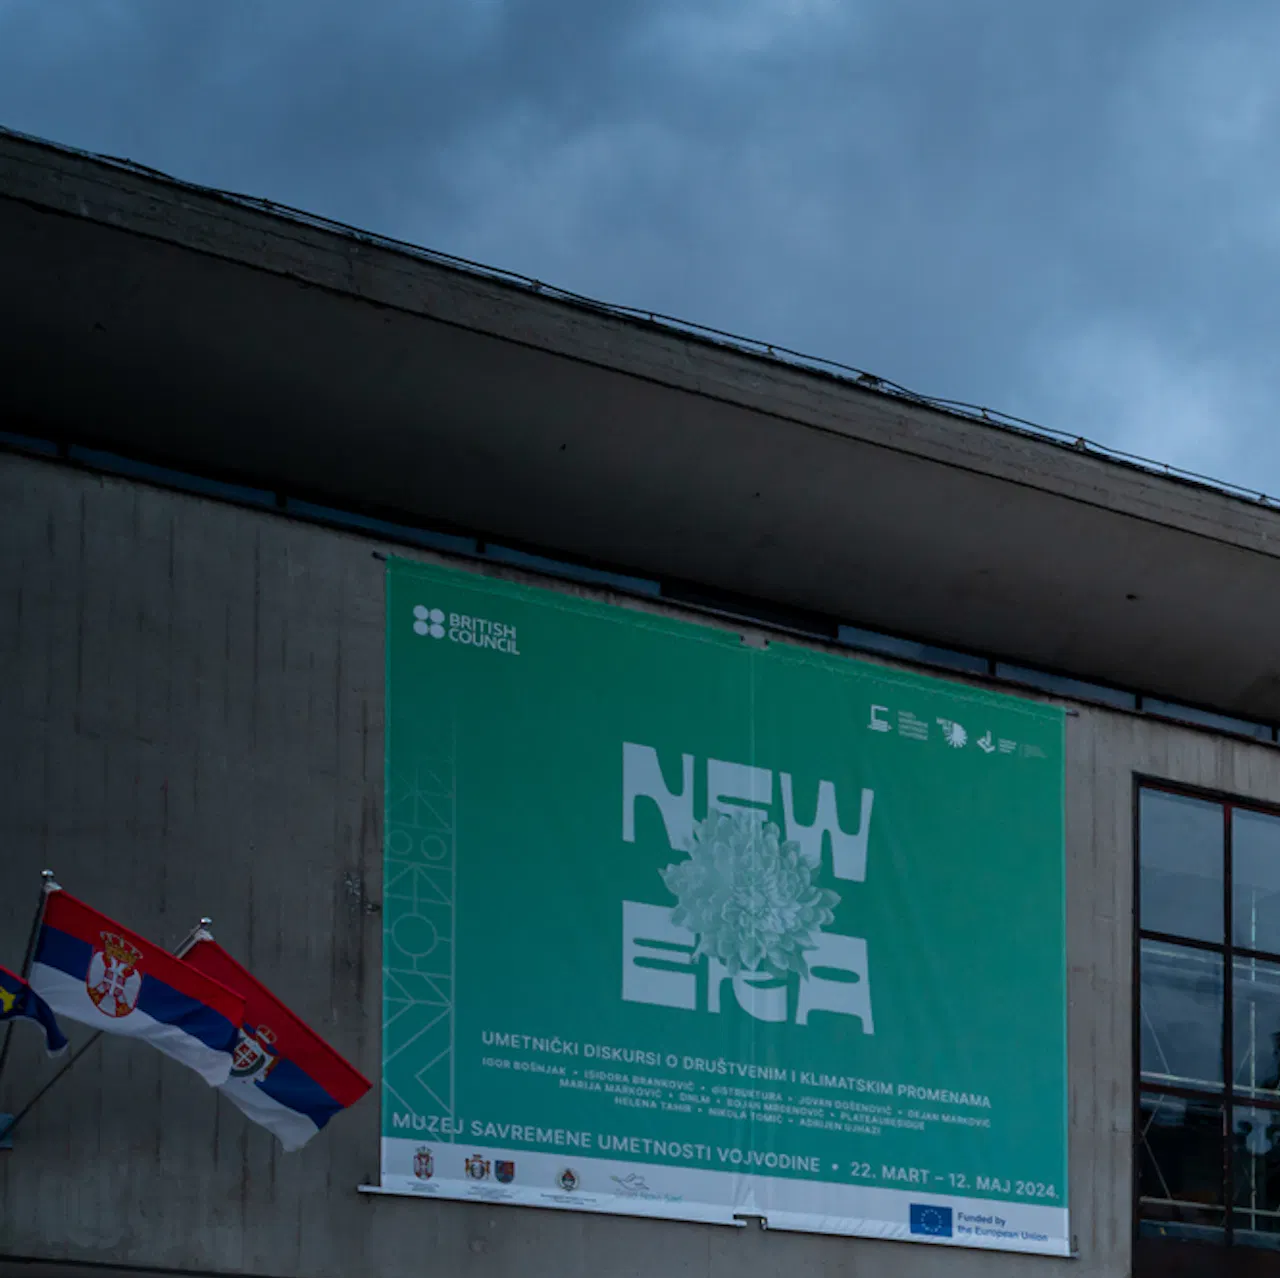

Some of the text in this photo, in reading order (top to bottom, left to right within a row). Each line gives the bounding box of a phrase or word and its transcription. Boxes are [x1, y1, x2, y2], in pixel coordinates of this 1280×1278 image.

[449, 612, 517, 640] BRITISH
[448, 627, 520, 656] COUNCIL
[622, 741, 874, 884] NEW
[481, 1030, 579, 1056] UMETNIČKI
[583, 1043, 661, 1066] DISKURSI
[666, 1054, 678, 1068] O
[683, 1055, 787, 1081] DRUŠTVENIM
[800, 1071, 894, 1096] KLIMATSKIM
[897, 1084, 991, 1109] PROMENAMA
[482, 1057, 511, 1069] IGOR
[584, 1069, 630, 1083] ISIDORA
[559, 1078, 602, 1093] MARIJA
[614, 1095, 657, 1109] HELENA
[392, 1112, 464, 1135] MUZEJ
[470, 1120, 592, 1150] SAVREMENE
[598, 1134, 712, 1162] UMETNOSTI
[716, 1149, 820, 1174] VOJVODINE
[850, 1161, 877, 1180] 22.
[882, 1164, 930, 1185] MART
[949, 1172, 971, 1190] 12.
[976, 1176, 1011, 1195] MAJ
[1016, 1179, 1060, 1201] 2024.
[957, 1211, 1006, 1228] Funded by
